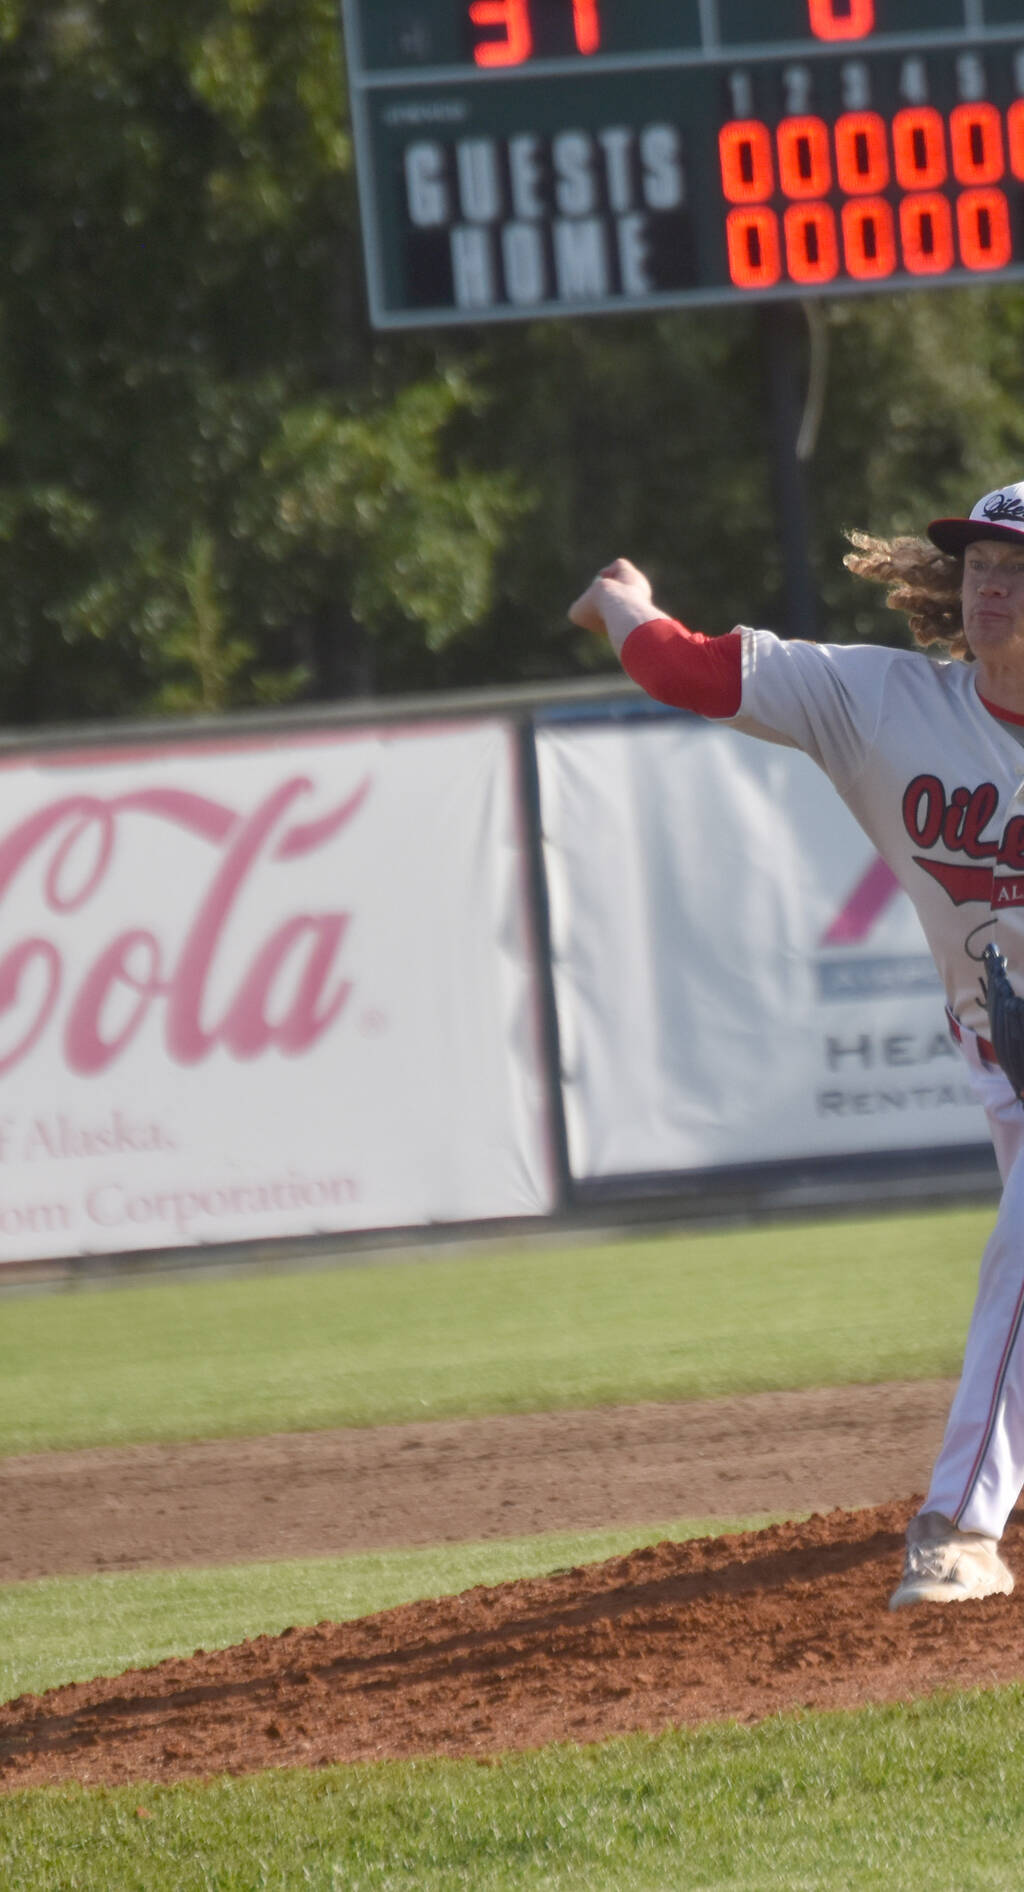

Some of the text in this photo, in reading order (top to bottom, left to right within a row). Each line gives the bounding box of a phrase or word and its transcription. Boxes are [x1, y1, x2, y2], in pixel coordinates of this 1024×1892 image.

[404, 122, 684, 228] GUESTS
[450, 214, 652, 308] HOME
[824, 1030, 962, 1073] HEA
[85, 1166, 358, 1234] Corporation
